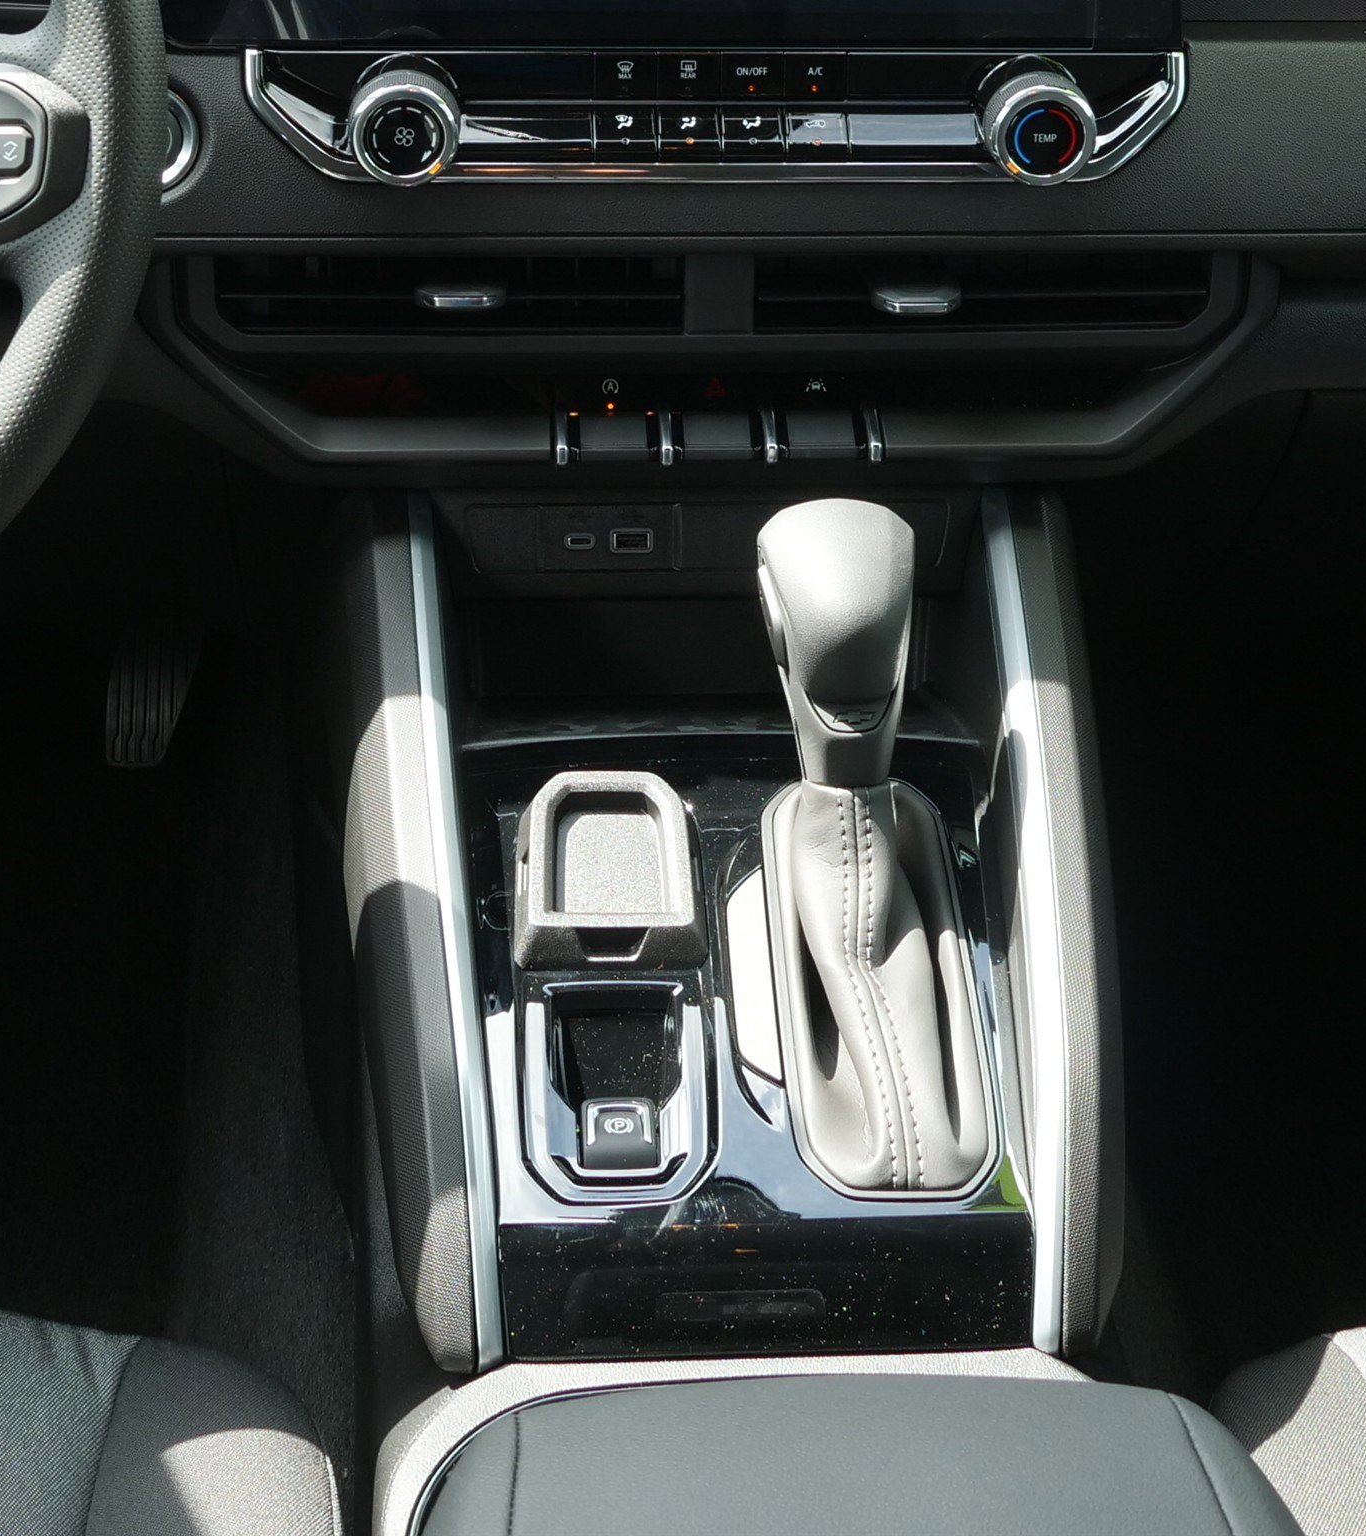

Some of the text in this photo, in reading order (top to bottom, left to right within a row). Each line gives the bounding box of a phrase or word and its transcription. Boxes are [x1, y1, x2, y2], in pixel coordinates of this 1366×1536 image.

[736, 66, 768, 76] ON/OFF
[807, 66, 823, 76] A/C
[1033, 133, 1058, 143] TEMP
